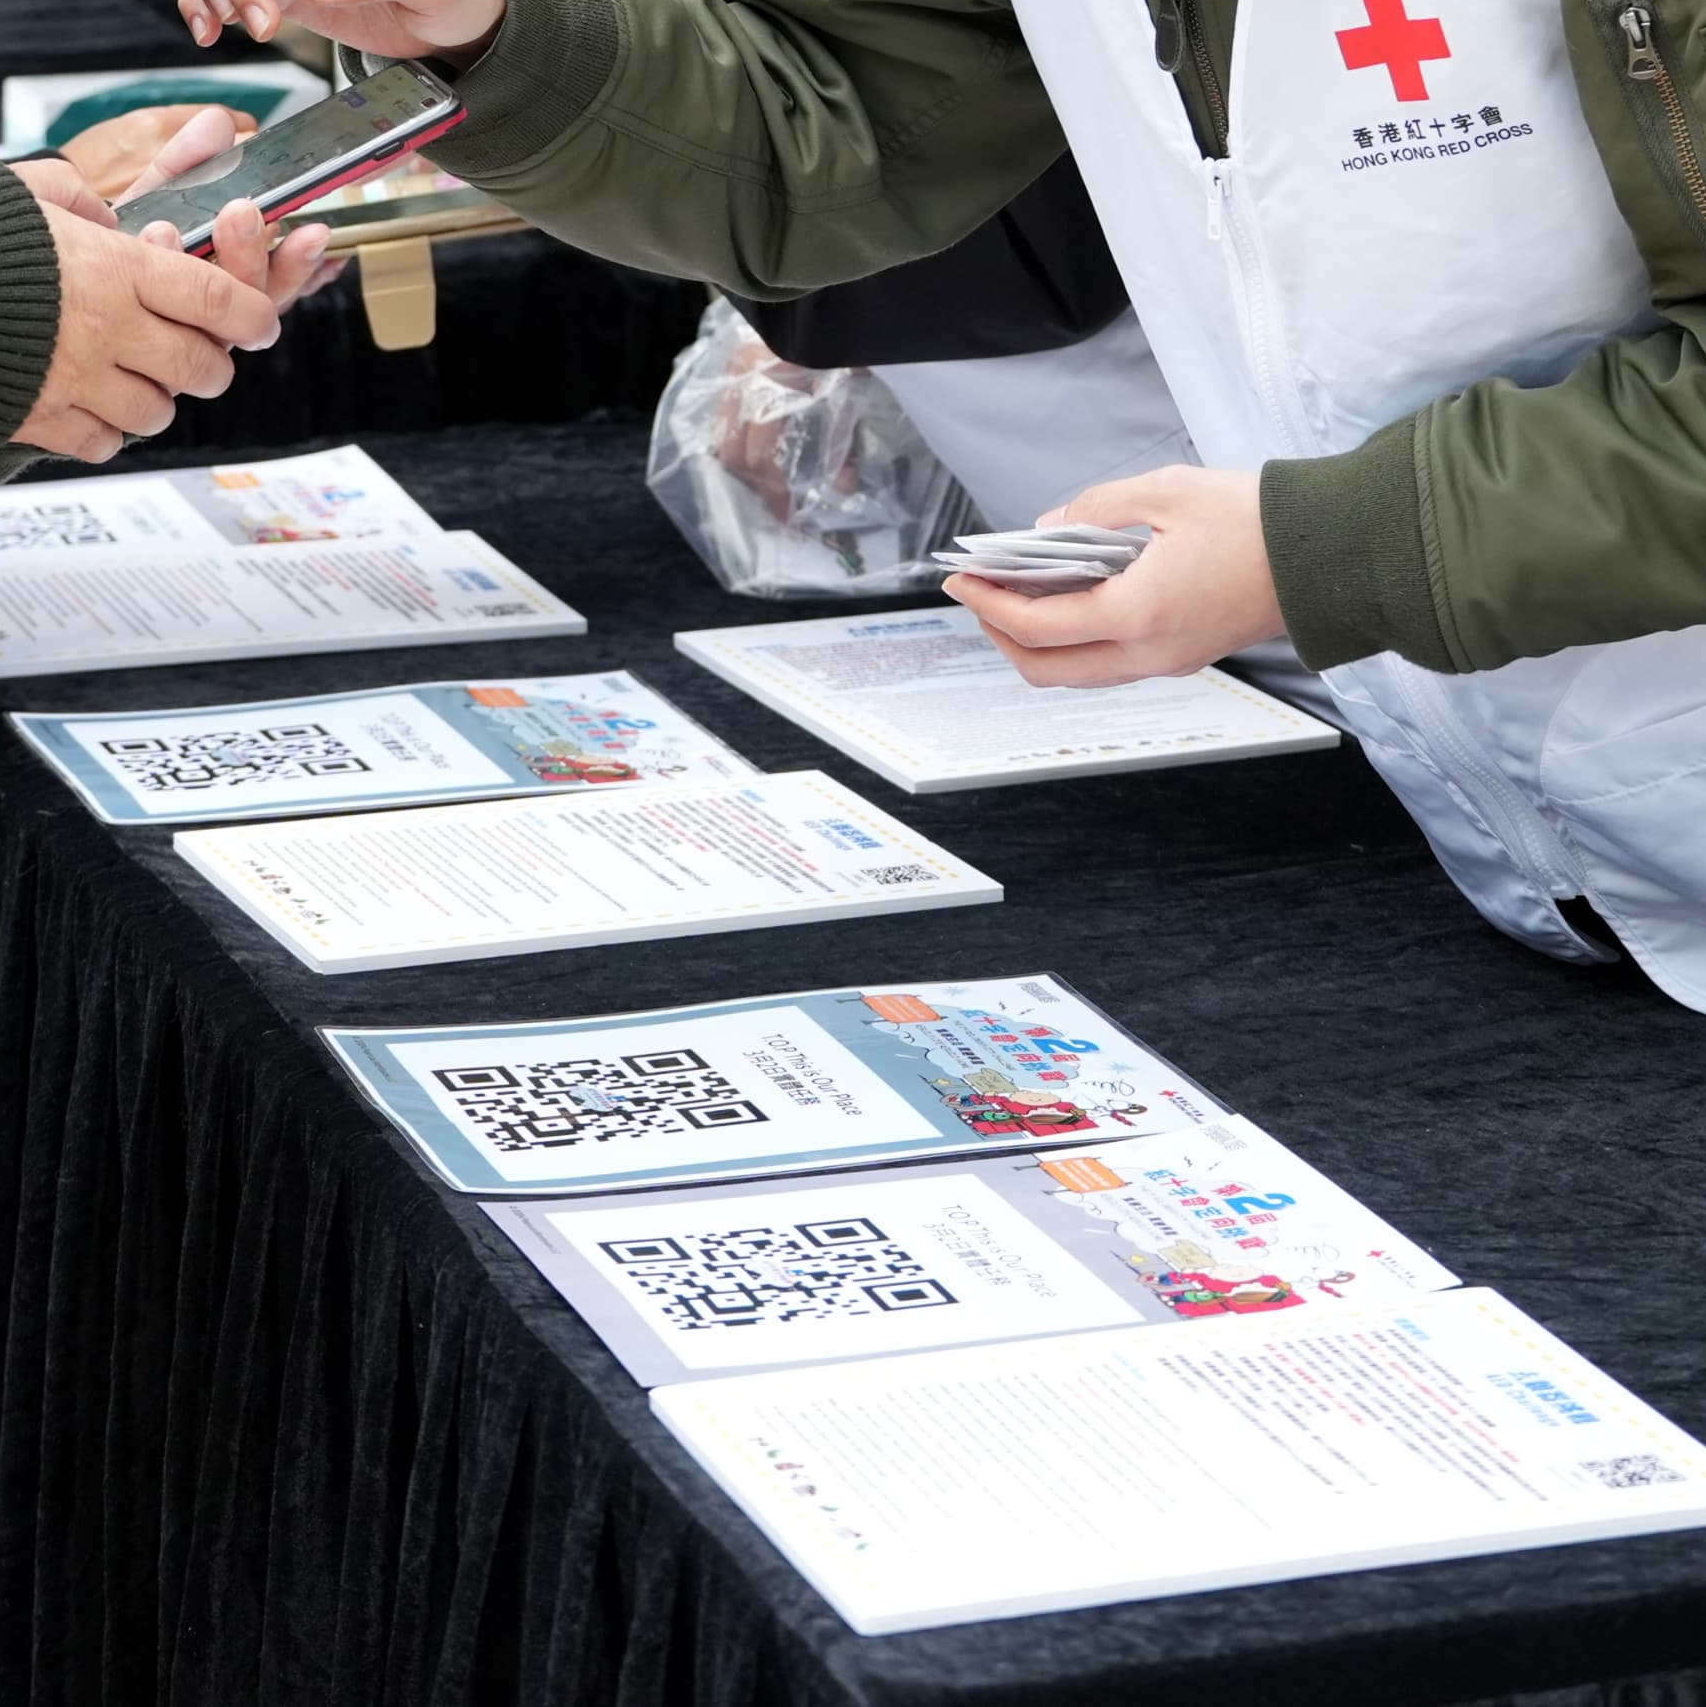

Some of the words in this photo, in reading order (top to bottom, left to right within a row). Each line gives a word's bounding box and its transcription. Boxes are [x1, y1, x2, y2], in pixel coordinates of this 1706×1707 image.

[1341, 152, 1389, 172] HONG
[1391, 146, 1435, 163] KONG
[1438, 140, 1470, 157] RED
[1474, 122, 1534, 149] CROSS
[1352, 105, 1504, 149] 香港紅十字會
[785, 1052, 814, 1070] This
[810, 1077, 838, 1093] Our
[828, 1093, 863, 1116] Place
